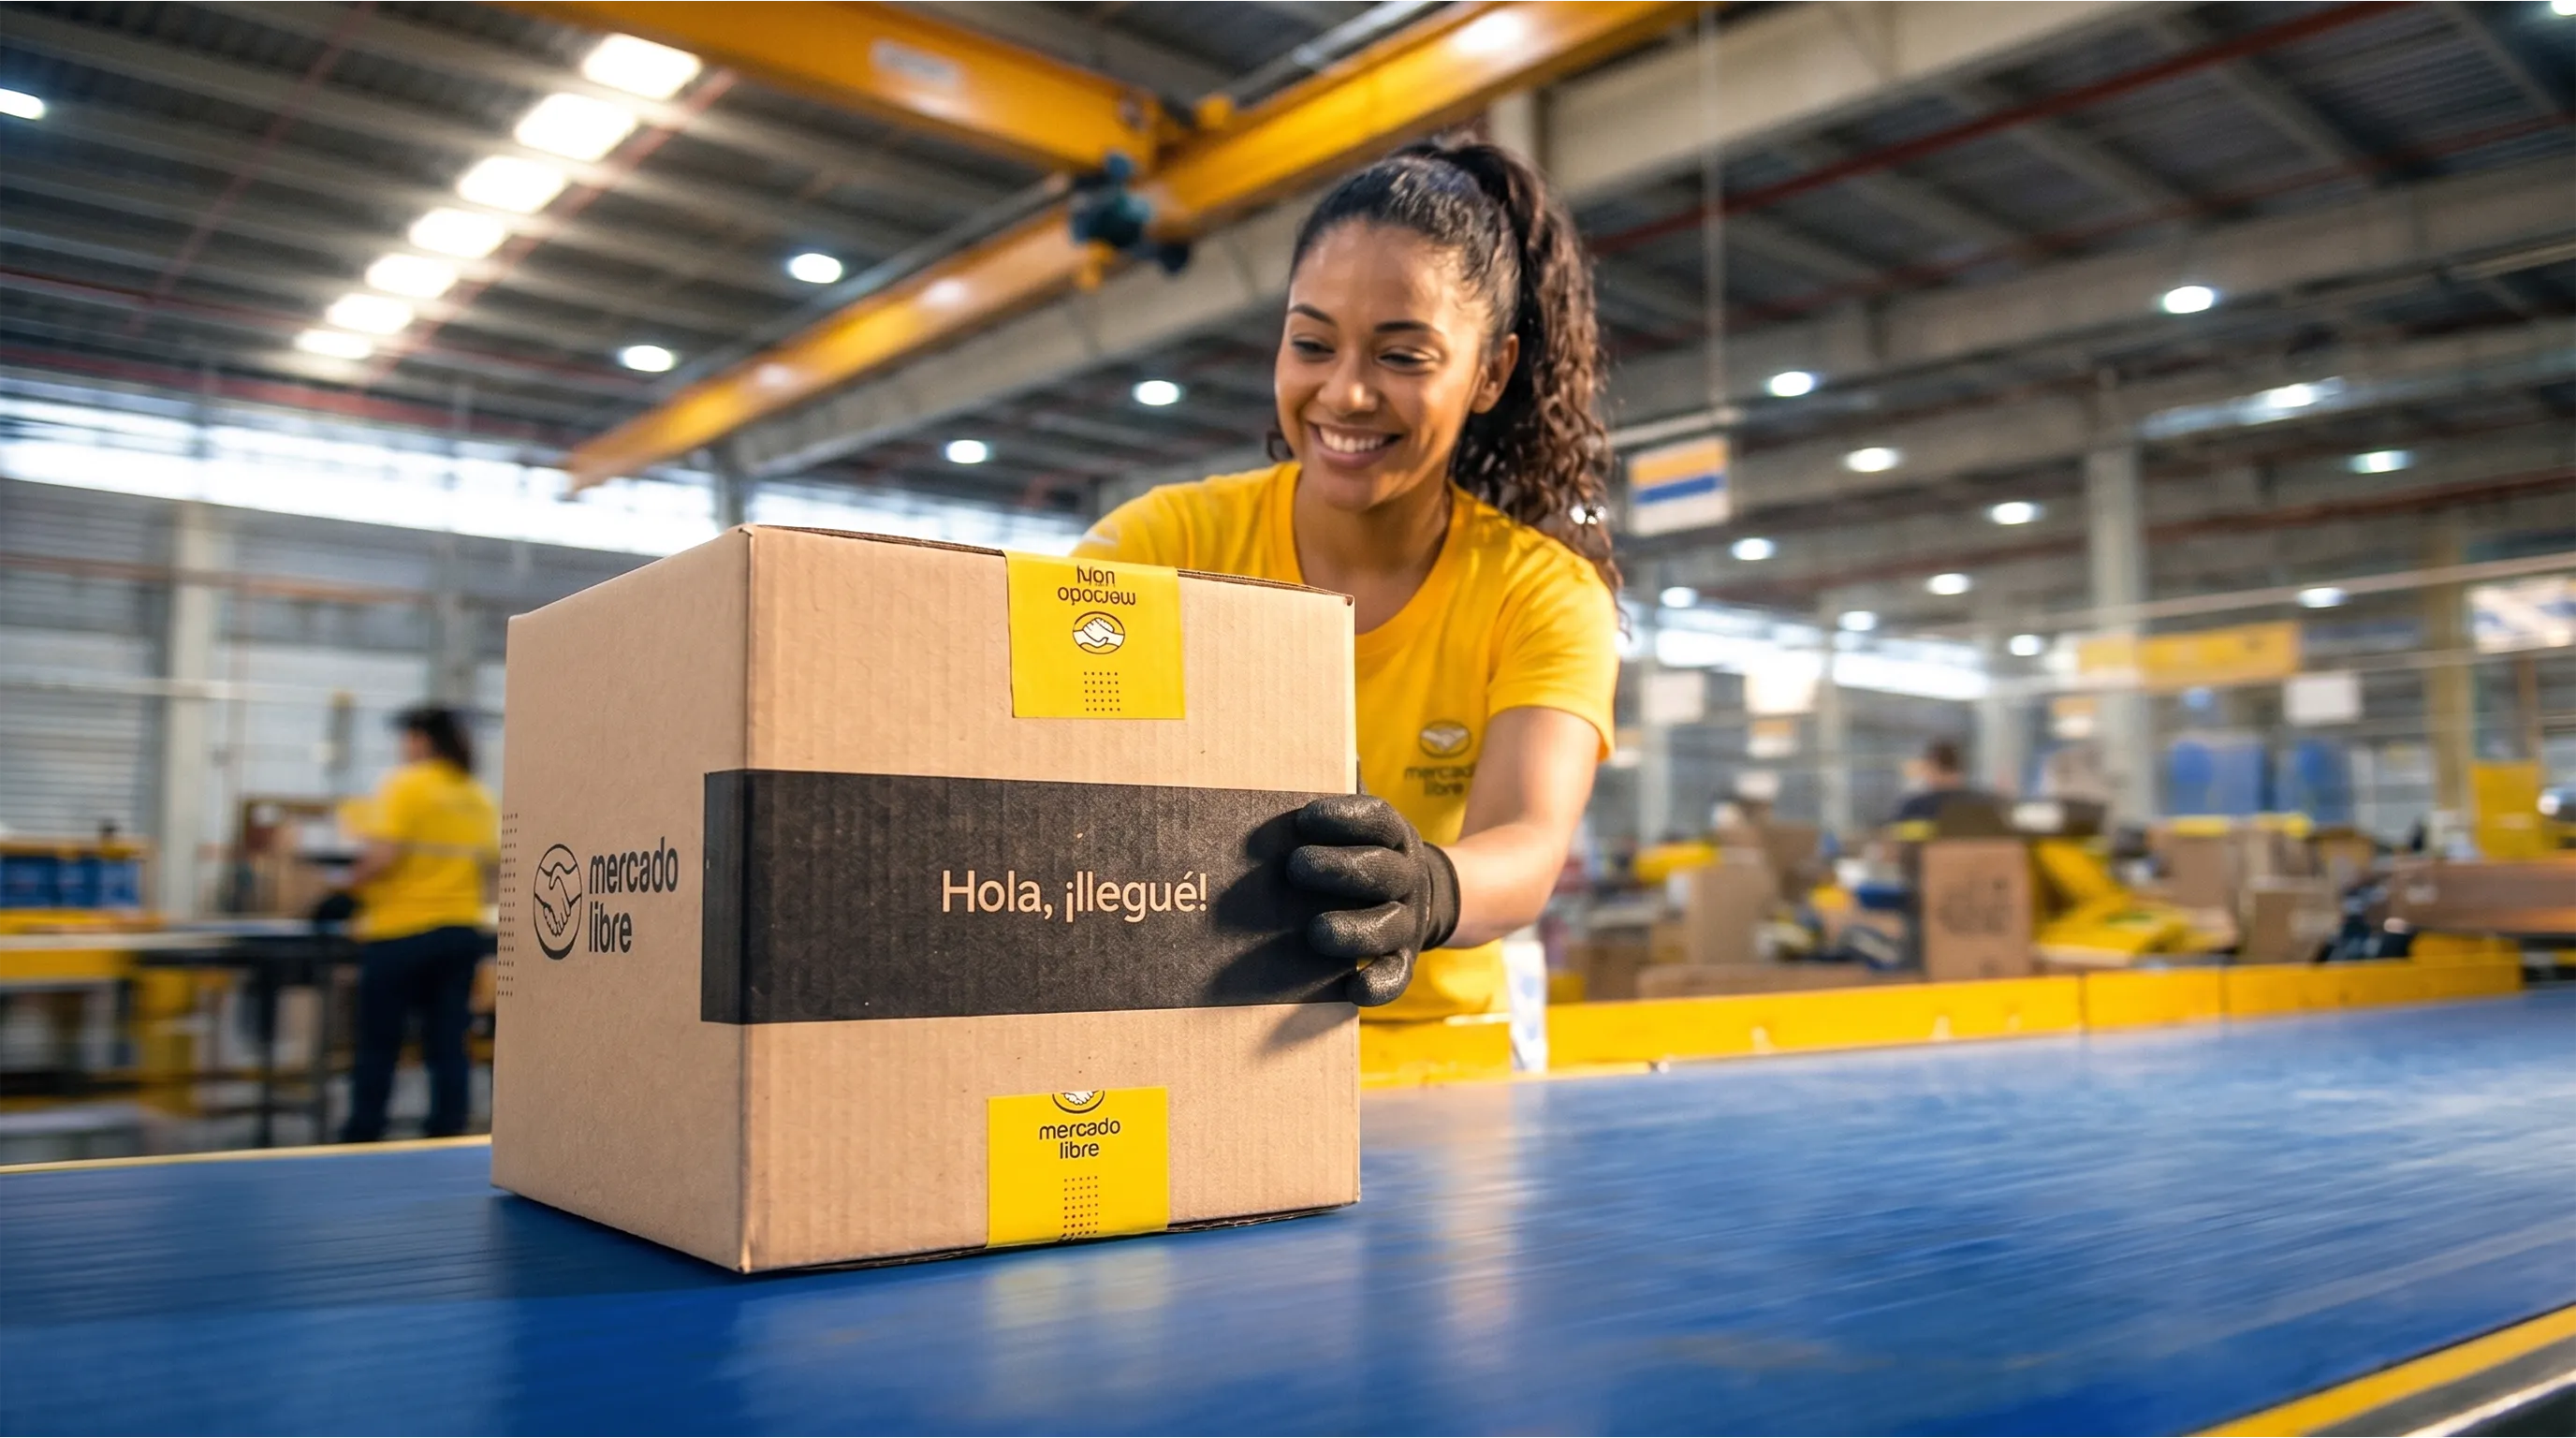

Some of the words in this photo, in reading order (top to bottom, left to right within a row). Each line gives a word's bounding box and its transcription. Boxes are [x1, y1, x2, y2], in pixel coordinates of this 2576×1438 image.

[589, 836, 679, 894] mercado
[943, 870, 1053, 920] Hola,
[1065, 871, 1207, 923] ¡llegué!
[589, 901, 633, 953] libre
[1039, 1117, 1120, 1140] mercado
[1060, 1141, 1099, 1159] libre
